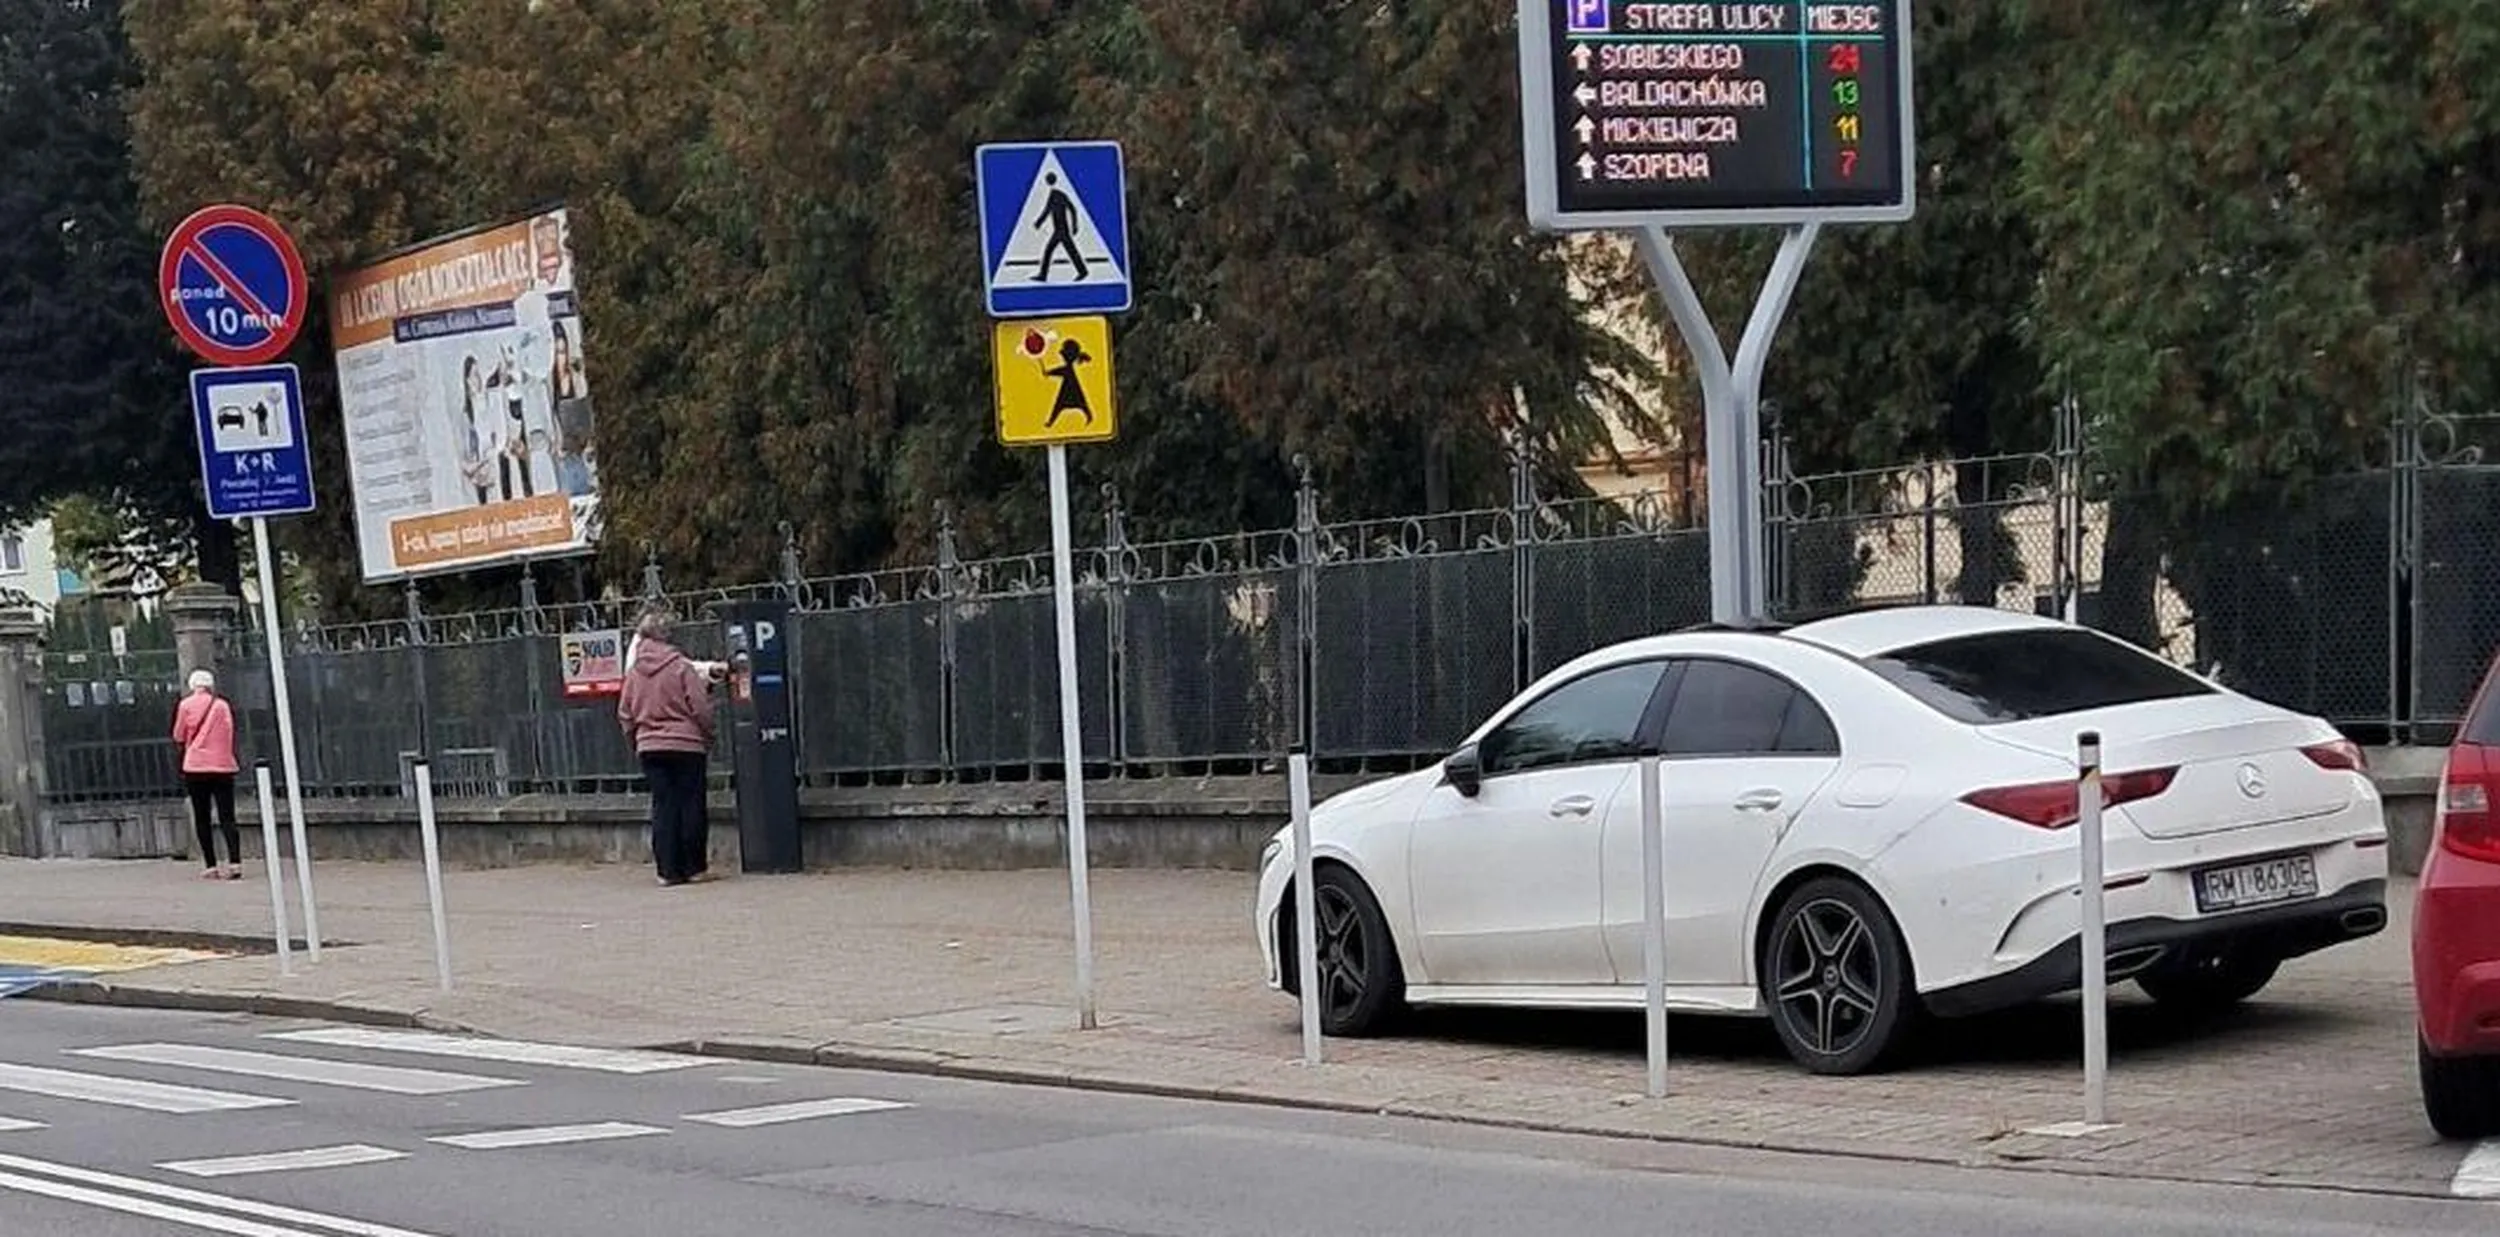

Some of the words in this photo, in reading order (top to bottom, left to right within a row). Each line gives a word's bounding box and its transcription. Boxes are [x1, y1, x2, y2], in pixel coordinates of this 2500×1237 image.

[1577, 0, 1599, 26] P
[1626, 6, 1714, 29] STREFA
[1722, 6, 1785, 30] ULICY
[1808, 6, 1880, 30] MIEJSC
[1601, 44, 1742, 69] SOBIESKIEGO
[1602, 76, 1766, 106] BALDACHÓWKA
[1833, 82, 1859, 104] 13
[1603, 116, 1738, 142] MICKIEWICZA
[1837, 116, 1860, 141] 11
[1604, 154, 1709, 180] SZOPENA
[1841, 151, 1858, 177] 7
[170, 283, 225, 304] ponad
[206, 307, 238, 336] 10
[242, 310, 283, 328] min
[755, 621, 775, 651] P
[2208, 870, 2246, 899] RMI
[2254, 858, 2314, 893] 8630E
